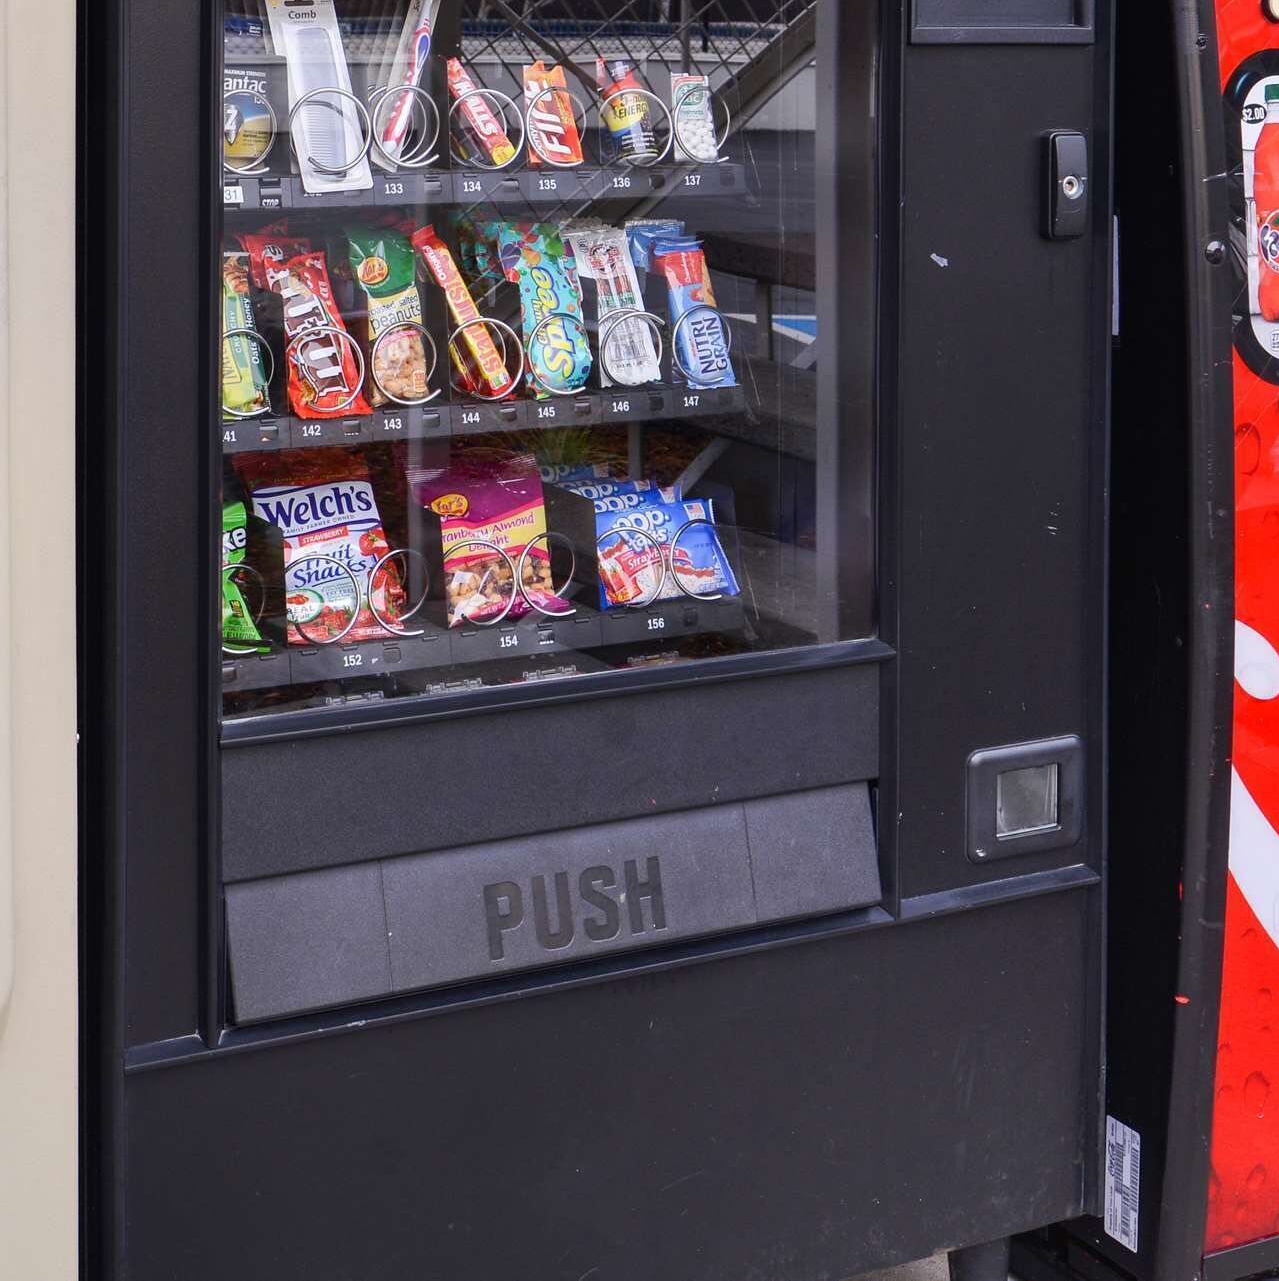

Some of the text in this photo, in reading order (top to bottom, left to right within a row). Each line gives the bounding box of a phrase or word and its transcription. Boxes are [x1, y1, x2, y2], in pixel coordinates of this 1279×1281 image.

[287, 10, 317, 20] Comb
[224, 76, 267, 94] antac
[453, 73, 498, 136] HALLS
[1242, 107, 1265, 121] $2.00
[463, 181, 482, 193] 134
[538, 179, 557, 190] 135
[613, 177, 631, 188] 136
[684, 175, 701, 186] 137
[224, 188, 239, 200] 31
[384, 183, 404, 195] 133
[370, 305, 421, 335] peanuts
[531, 267, 576, 379] Spree
[244, 298, 260, 365] Oats Honey
[691, 320, 718, 375] NUTRI
[704, 316, 728, 371] GRAIN
[612, 401, 630, 413] 146
[683, 396, 700, 407] 147
[462, 411, 481, 424] 144
[538, 406, 556, 418] 145
[302, 425, 321, 437] 142
[384, 419, 402, 431] 143
[257, 485, 373, 528] Welch's
[306, 519, 331, 530] FARMER
[491, 512, 535, 536] Almond
[302, 527, 345, 545] STRAWBERRY
[627, 547, 681, 570] Strawberry
[293, 558, 368, 589] Snacks
[647, 617, 665, 630] 156
[500, 635, 518, 647] 154
[343, 654, 362, 667] 152
[483, 855, 668, 962] PUSH
